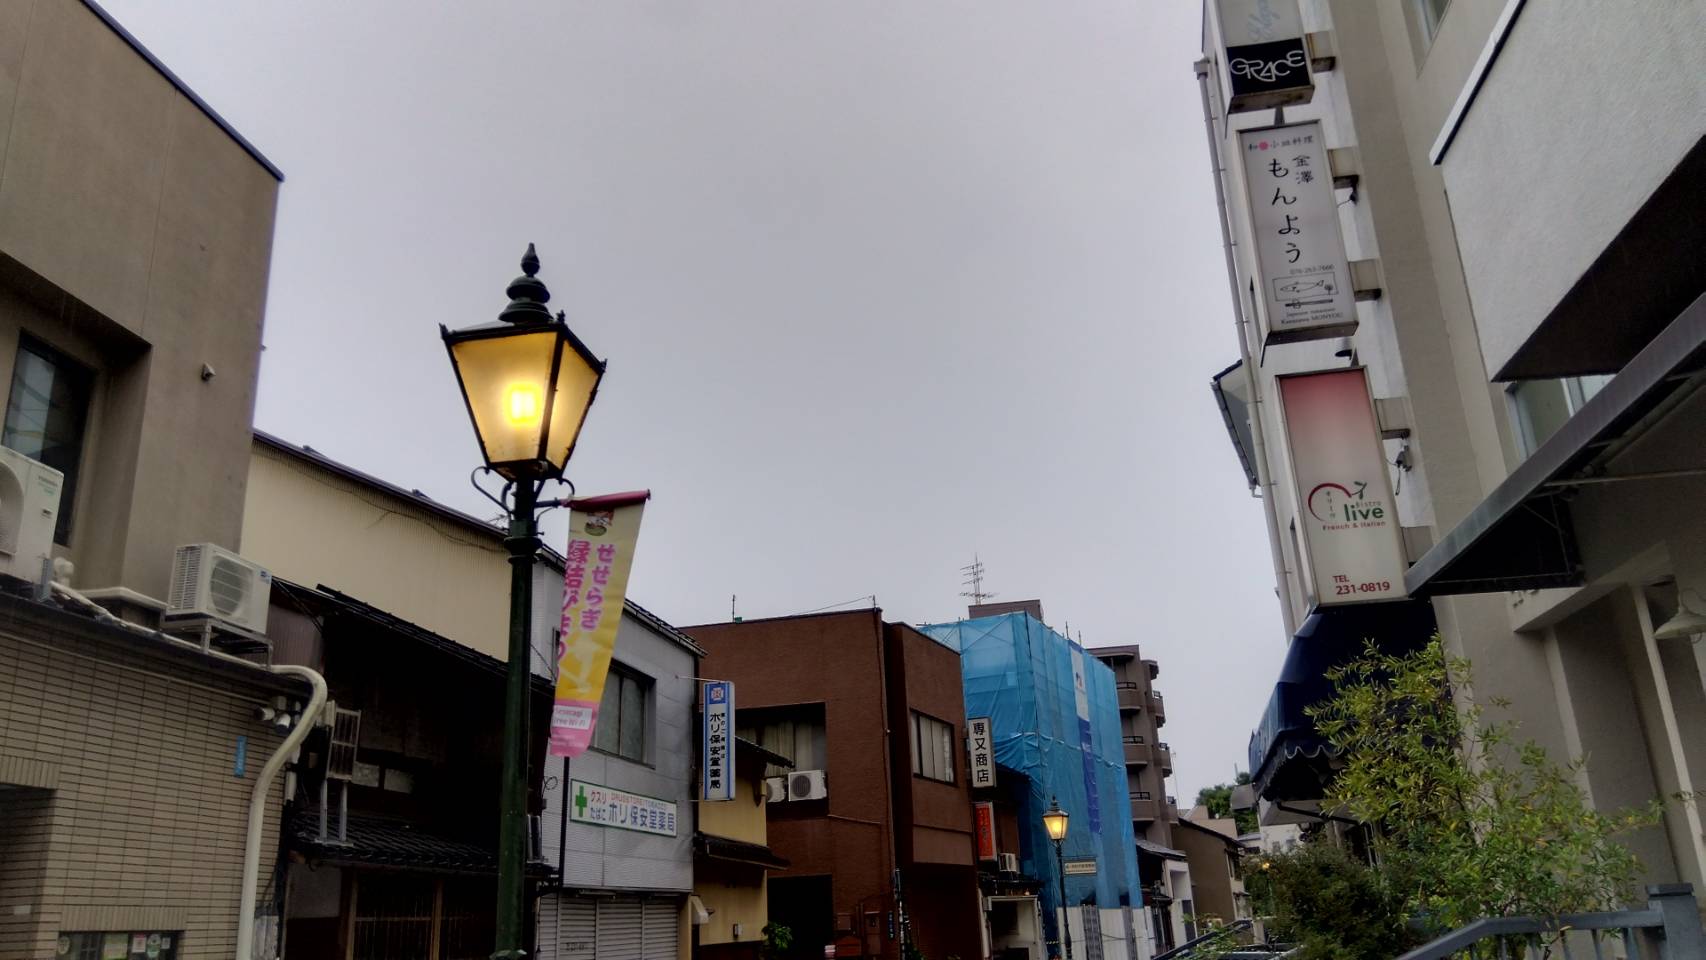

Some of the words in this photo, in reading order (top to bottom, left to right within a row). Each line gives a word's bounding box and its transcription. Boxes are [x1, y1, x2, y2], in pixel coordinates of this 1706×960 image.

[1230, 49, 1305, 82] GRACE
[1268, 158, 1301, 263] もんよう
[1343, 503, 1384, 522] live
[581, 543, 615, 632] せせらぎ
[1332, 574, 1350, 583] TEL
[1335, 581, 1391, 595] 231-0819
[710, 713, 721, 789] ホリ保安堂薬局
[591, 791, 607, 804] クスリ
